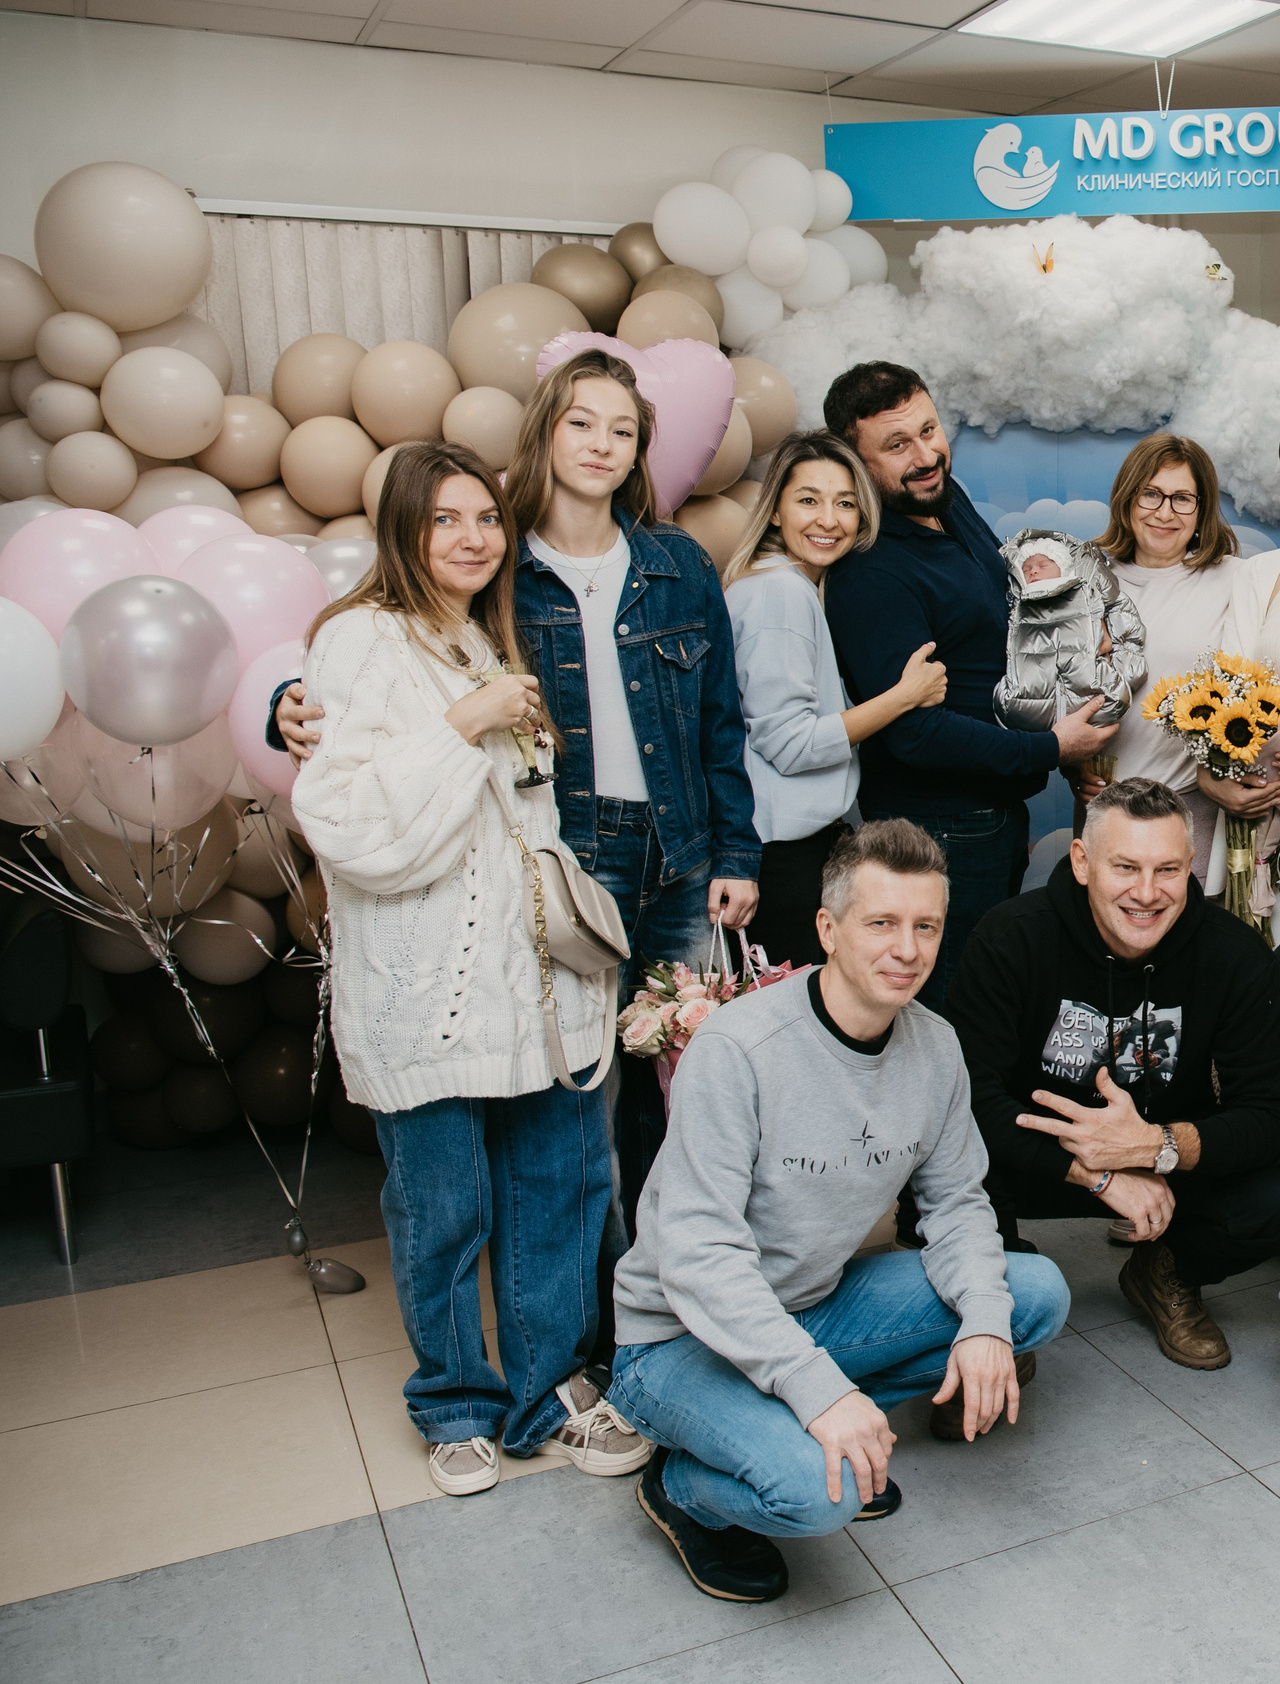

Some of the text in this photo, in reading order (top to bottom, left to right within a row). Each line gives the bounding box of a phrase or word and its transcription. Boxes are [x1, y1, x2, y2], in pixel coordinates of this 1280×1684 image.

[1073, 116, 1156, 160] MD
[1077, 168, 1222, 191] КЛИНИЧЕСКИЙ
[1060, 1009, 1095, 1032] GET
[1051, 1031, 1106, 1049] ASS UP
[1054, 1051, 1086, 1067] AND
[1041, 1061, 1085, 1081] WIN!
